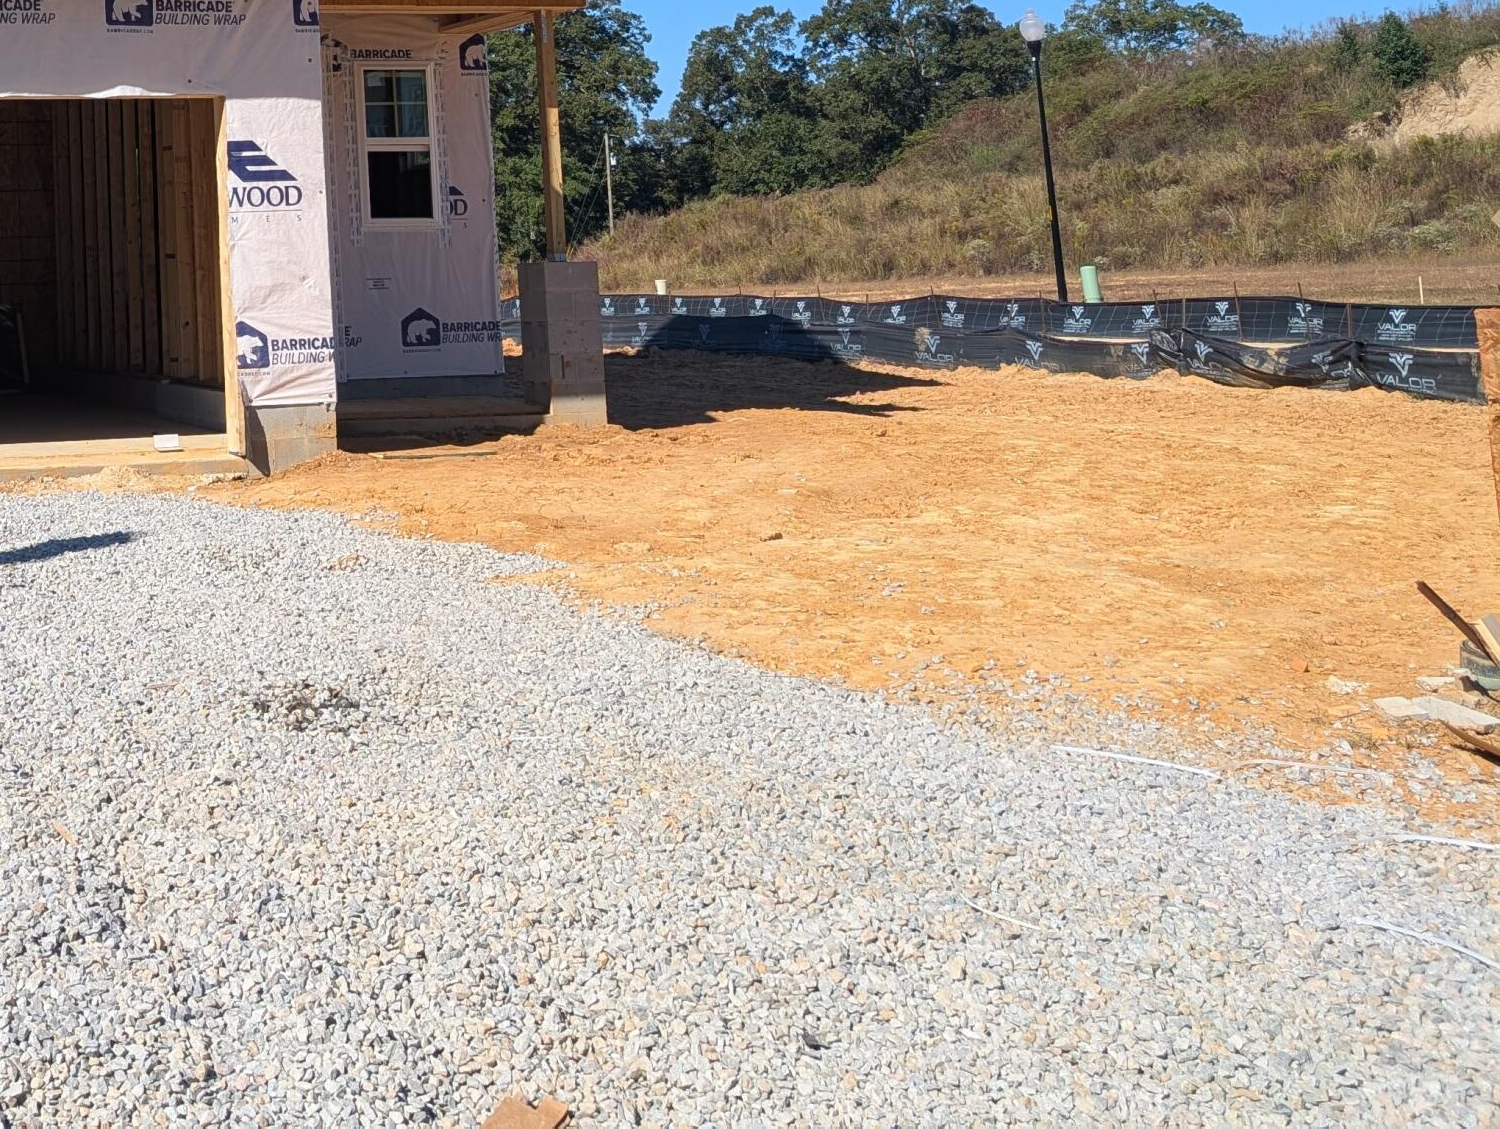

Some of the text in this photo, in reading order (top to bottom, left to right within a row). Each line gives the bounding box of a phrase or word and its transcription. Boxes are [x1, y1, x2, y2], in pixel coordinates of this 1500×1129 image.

[156, 0, 232, 13] BARRICADE
[20, 12, 56, 25] WRAP
[155, 13, 246, 26] BUILDING WRAP
[350, 49, 412, 59] BARRICADE
[228, 185, 302, 208] WOOD
[1064, 317, 1092, 325] VALOR
[1207, 315, 1238, 323] VALOR
[1288, 317, 1323, 325] VALOR
[442, 321, 500, 332] BARRICADE
[1378, 323, 1416, 331] VALOR
[344, 337, 362, 347] RAP
[442, 332, 500, 343] BUILDING WR
[271, 336, 335, 351] BARRICAD
[831, 343, 862, 351] VALOR
[272, 351, 325, 365] BUILDING
[915, 351, 954, 363] VALOR
[1376, 372, 1436, 390] VALOR
